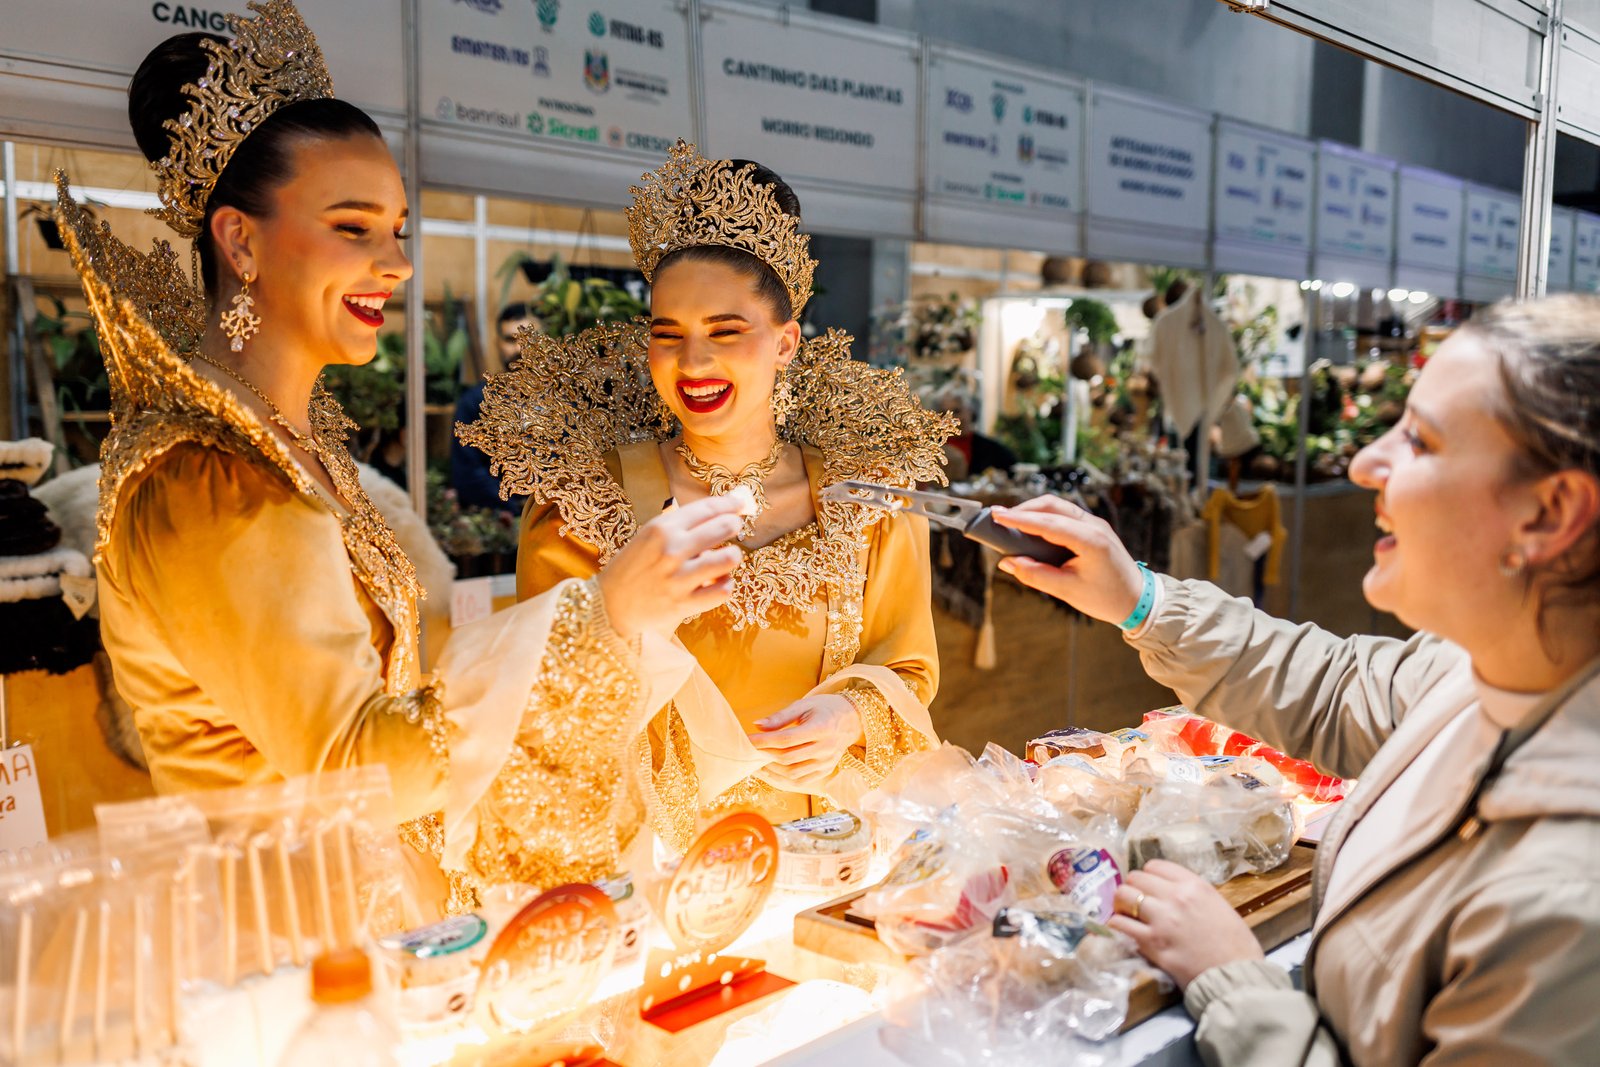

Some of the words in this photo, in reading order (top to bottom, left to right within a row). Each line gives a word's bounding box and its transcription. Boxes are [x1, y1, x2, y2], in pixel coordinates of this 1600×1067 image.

[723, 58, 806, 88] CANTINHO
[809, 74, 838, 93] DAS
[842, 79, 904, 105] PLANTAS
[456, 102, 521, 129] banrisul
[547, 119, 599, 142] Sicredi
